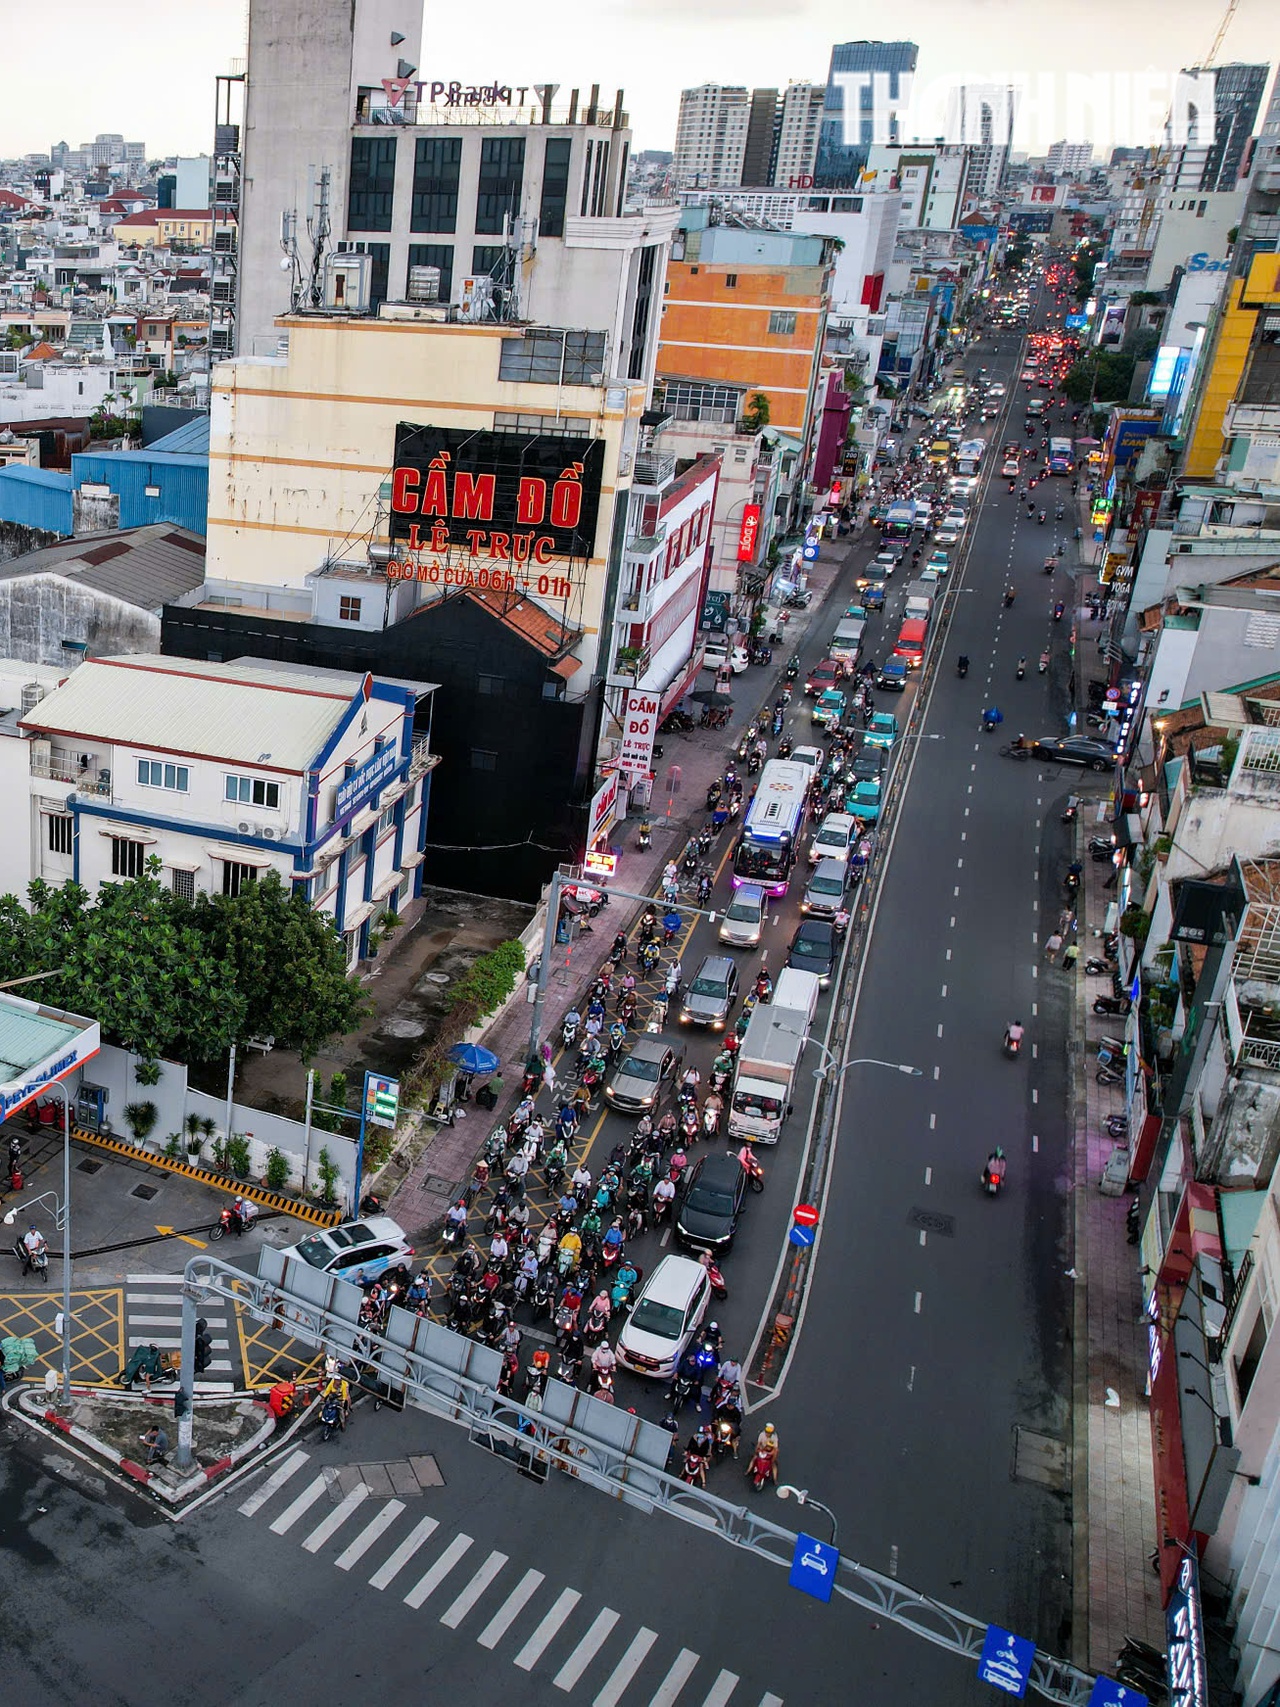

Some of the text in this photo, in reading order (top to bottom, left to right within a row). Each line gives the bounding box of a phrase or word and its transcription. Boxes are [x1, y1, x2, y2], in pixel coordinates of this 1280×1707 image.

[414, 80, 507, 103] TPBank
[392, 451, 585, 529] CẦM ĐỒ
[408, 519, 556, 569] LÊ TRỰC
[387, 559, 414, 580] GIỜ
[417, 560, 440, 583] MỞ
[444, 564, 476, 588] CỬA
[477, 568, 515, 593] 06h
[537, 574, 572, 598] 01h
[1115, 565, 1134, 578] GYM
[1111, 581, 1131, 594] YOGA
[629, 696, 657, 714] CẦM
[629, 718, 650, 735] ĐỒ
